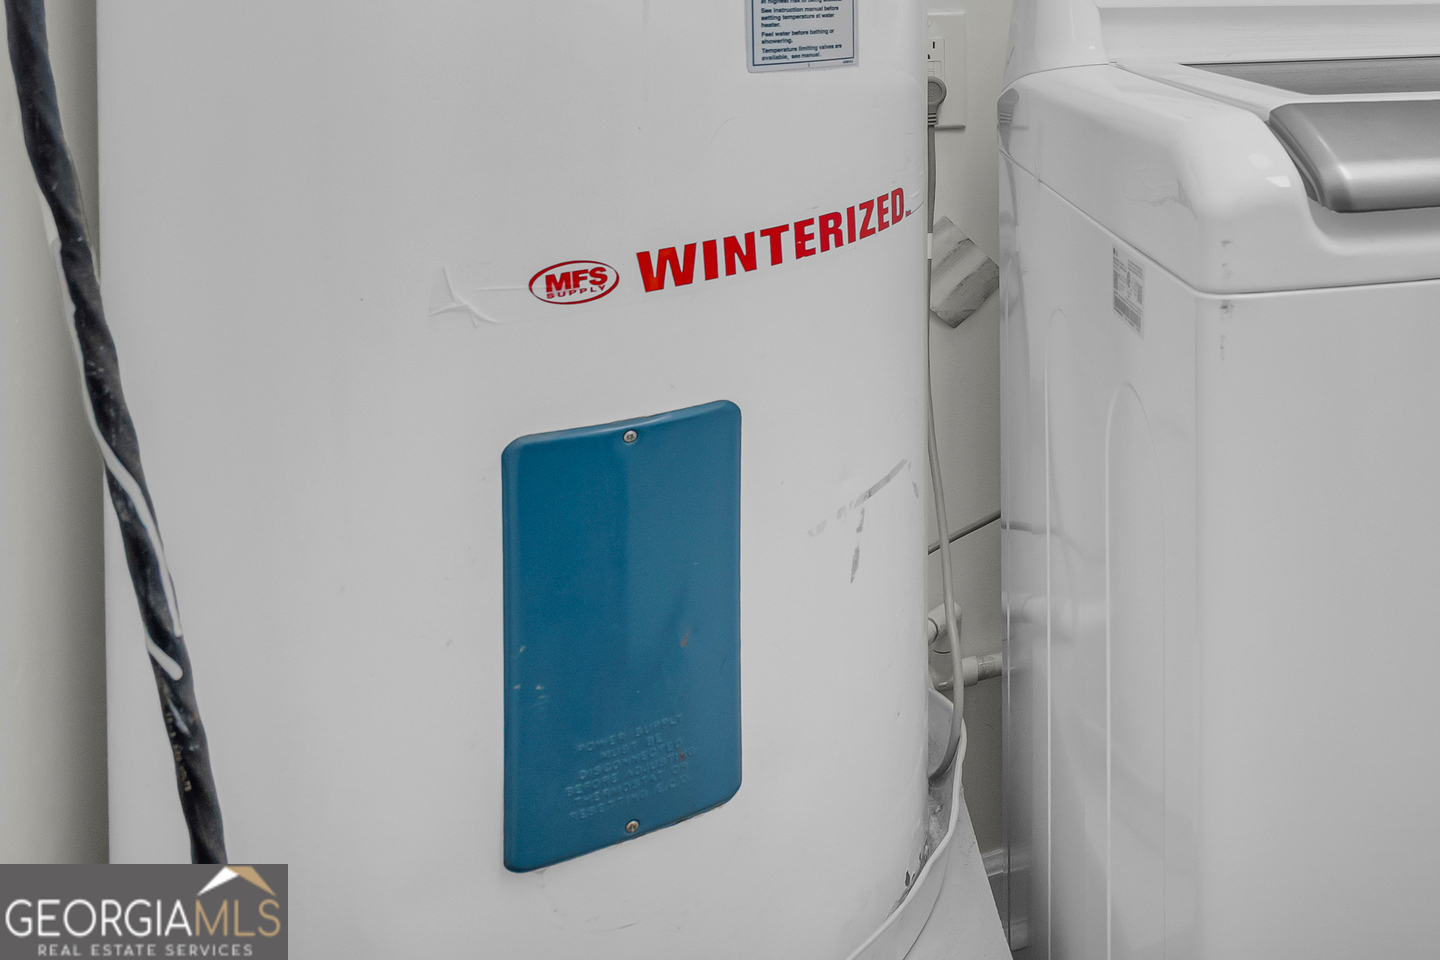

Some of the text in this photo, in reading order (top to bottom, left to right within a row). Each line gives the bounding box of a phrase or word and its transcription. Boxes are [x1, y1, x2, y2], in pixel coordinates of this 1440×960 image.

[636, 186, 905, 294] WINTERIZED
[545, 266, 608, 294] MFS
[546, 285, 607, 300] SUPPLY
